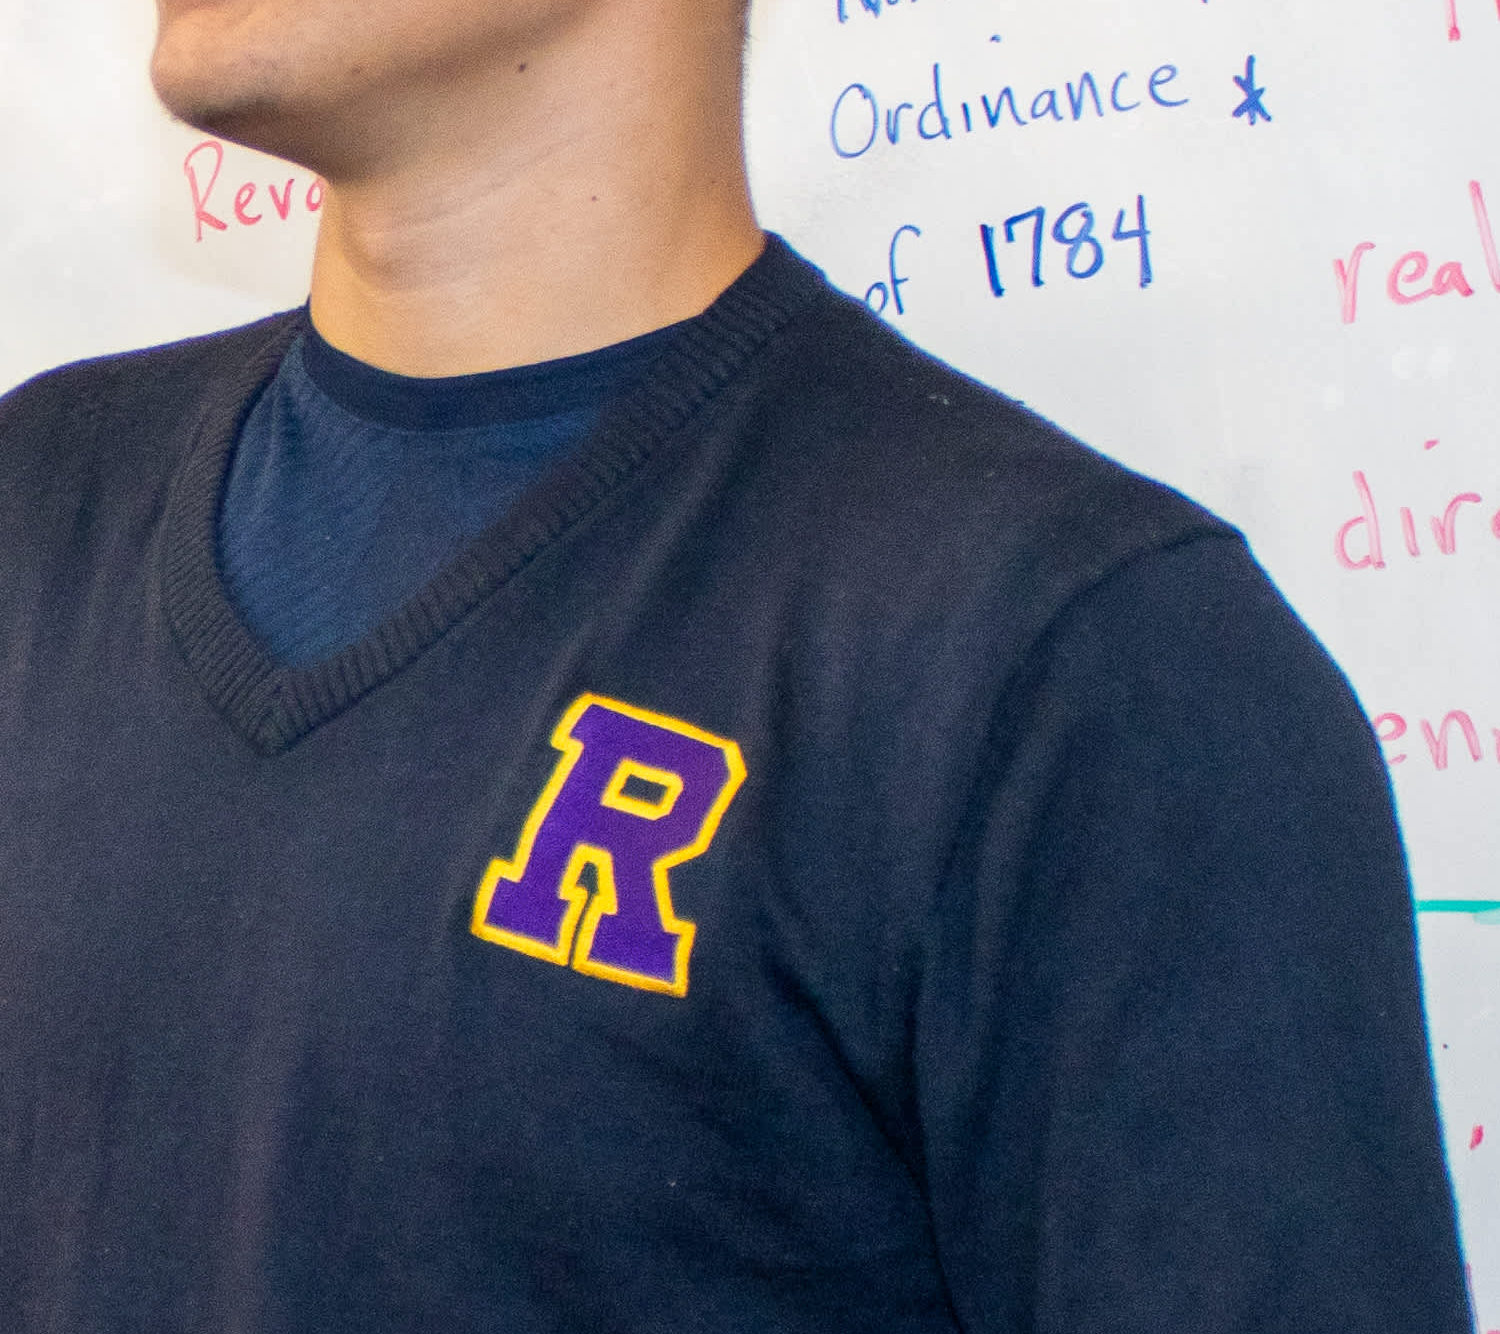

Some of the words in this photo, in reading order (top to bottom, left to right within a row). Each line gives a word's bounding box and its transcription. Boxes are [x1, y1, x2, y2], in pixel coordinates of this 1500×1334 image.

[829, 34, 1190, 160] Ordinance
[866, 224, 922, 317] of
[979, 193, 1155, 299] 1784
[470, 691, 748, 999] R
